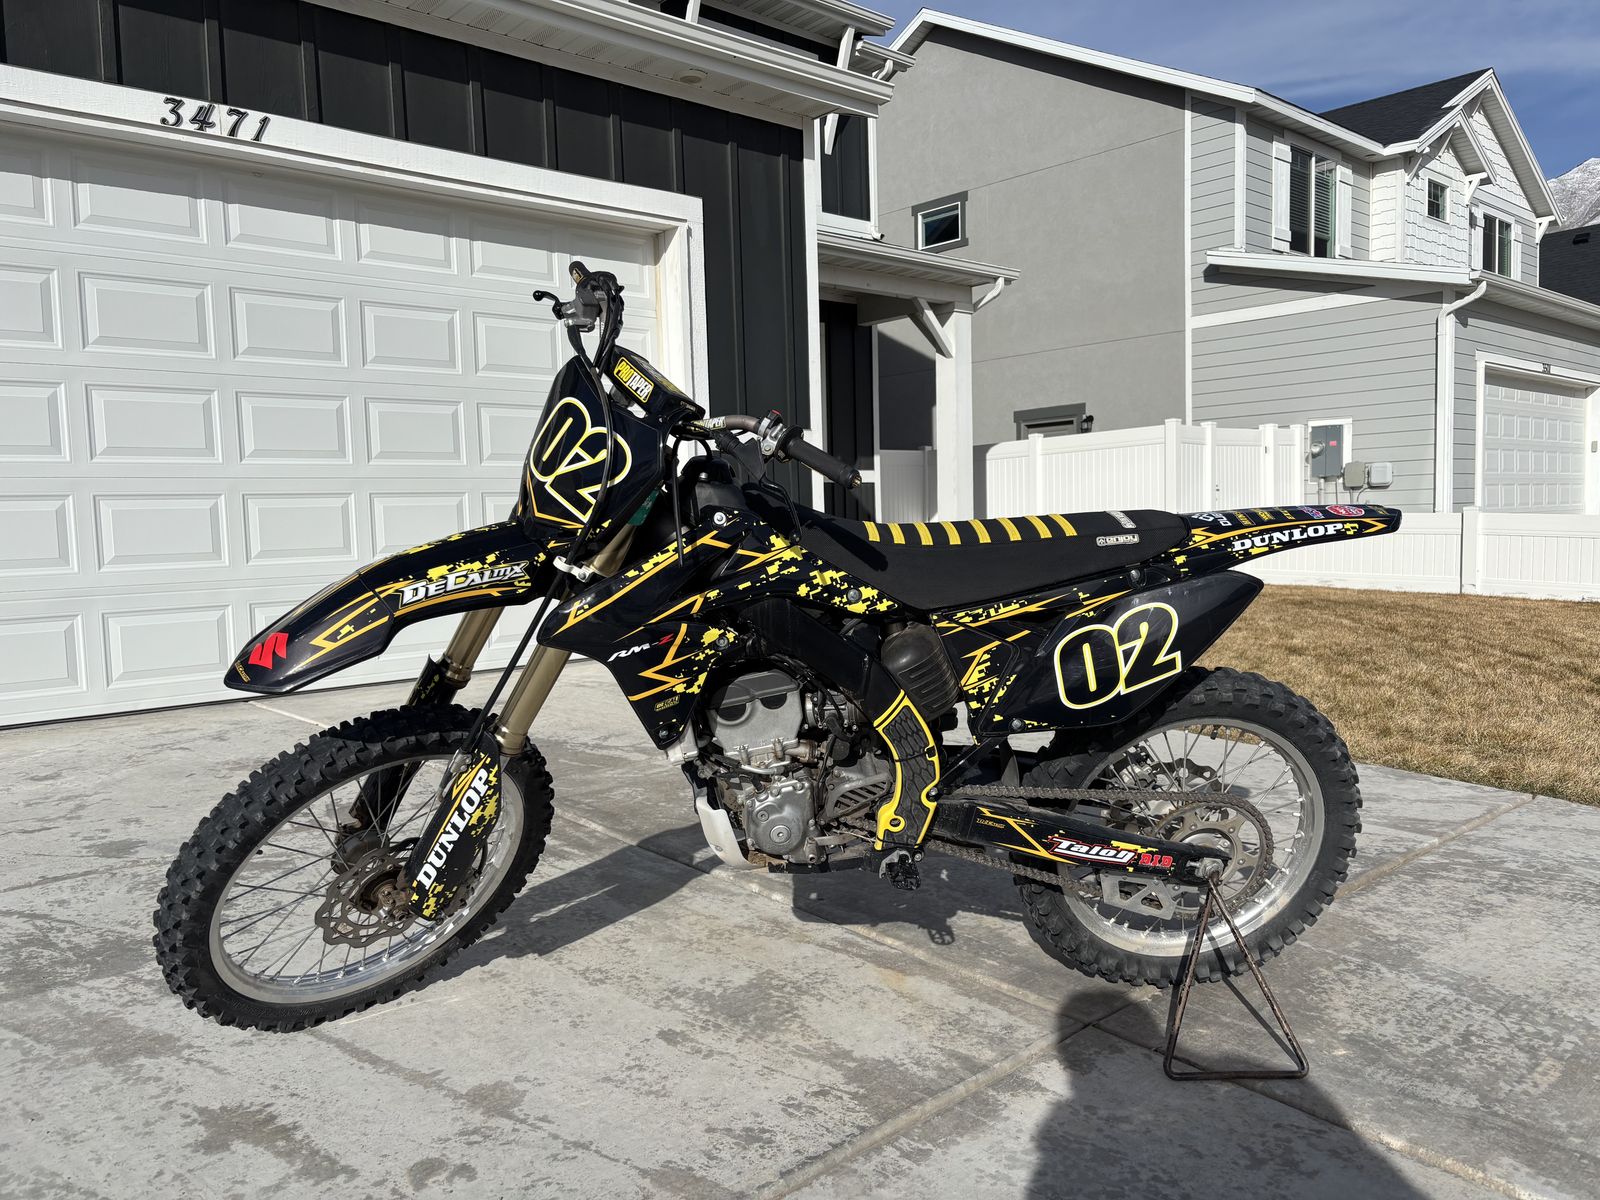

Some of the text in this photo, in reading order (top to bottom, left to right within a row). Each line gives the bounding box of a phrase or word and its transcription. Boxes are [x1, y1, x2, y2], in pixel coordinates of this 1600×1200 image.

[160, 96, 271, 142] 3471
[530, 397, 632, 524] 02
[1232, 523, 1345, 551] DUNLOP
[1054, 602, 1182, 709] 02
[416, 768, 489, 890] DUNLOP
[1052, 838, 1136, 864] Talon
